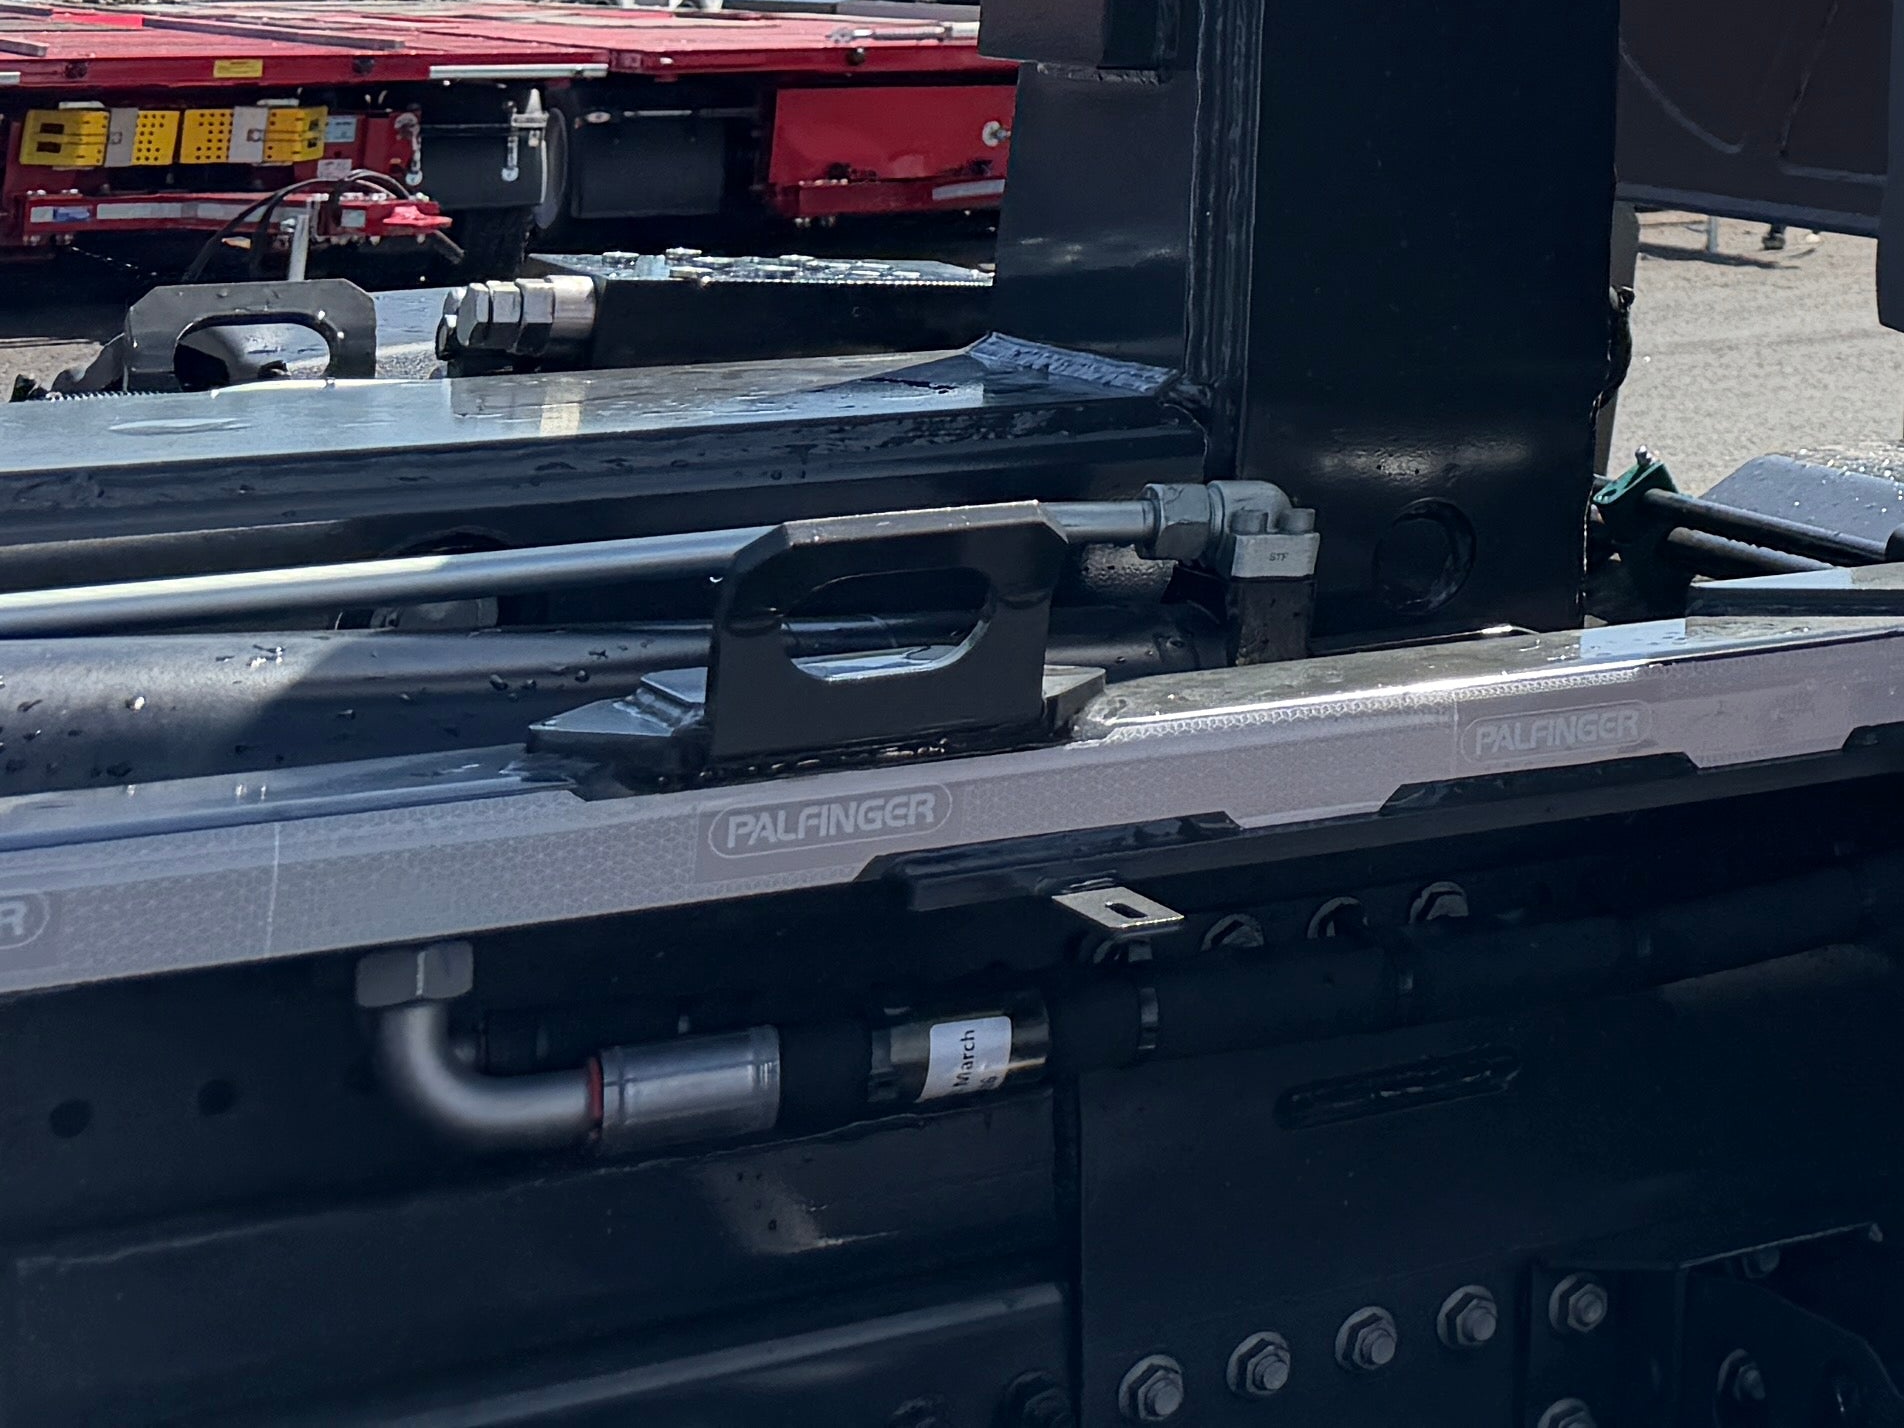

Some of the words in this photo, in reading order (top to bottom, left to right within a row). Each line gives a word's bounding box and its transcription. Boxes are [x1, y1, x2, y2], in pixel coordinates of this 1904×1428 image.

[1475, 709, 1641, 756] PALFINGER
[726, 792, 938, 850] PALFINGER
[952, 1029, 976, 1088] March
